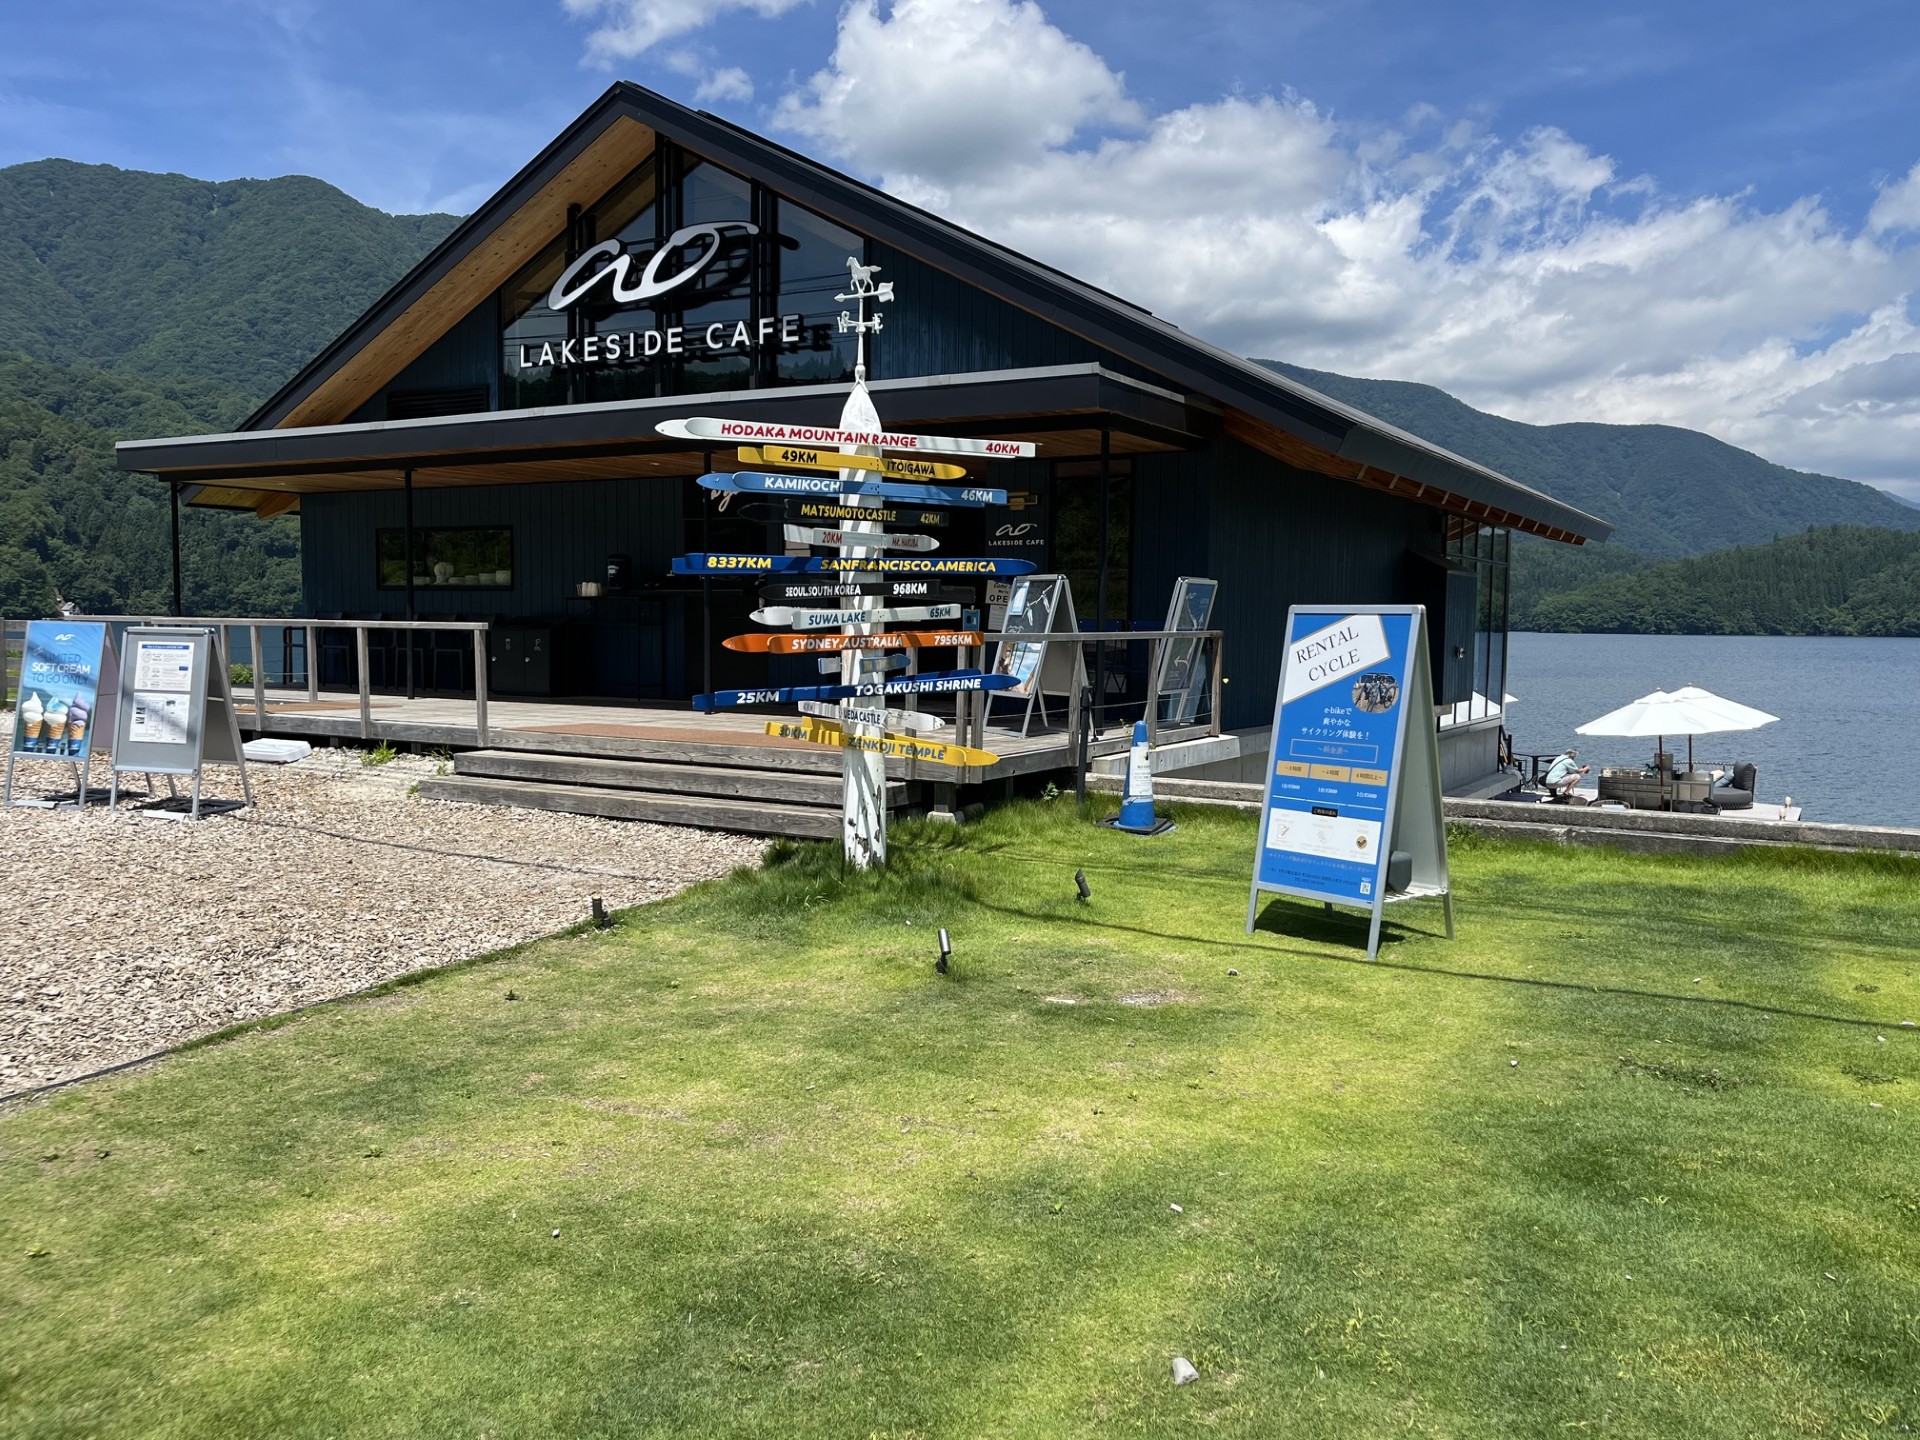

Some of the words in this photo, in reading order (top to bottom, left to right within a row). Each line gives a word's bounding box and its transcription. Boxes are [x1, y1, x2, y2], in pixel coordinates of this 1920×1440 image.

[520, 326, 683, 368] LAKESIDE
[705, 314, 800, 349] CAFE
[721, 424, 786, 439] HODAKA
[789, 428, 869, 444] MOUNTAIN
[872, 434, 917, 448] RANGE
[986, 443, 1020, 454] 40KM
[781, 450, 817, 463] 49KM
[886, 461, 936, 476] ITOIGAWA
[765, 477, 843, 492] KAMIKOCHI
[961, 490, 993, 503] 46KM
[801, 504, 865, 519] MATSUMOTO
[866, 509, 896, 522] CASTLE
[920, 513, 940, 524] 42KM
[822, 531, 842, 544] 20KM
[707, 556, 771, 569] 8337KM
[834, 584, 861, 596] KOREA
[893, 583, 927, 595] 968KM
[989, 594, 1008, 603] OPE
[808, 613, 839, 626] SUWA
[841, 612, 866, 624] LAKE
[929, 607, 951, 618] 65KM
[934, 634, 972, 645] 7956KM
[1296, 626, 1359, 664] RENTAL
[44, 653, 81, 663] LIMITED
[1308, 648, 1360, 682] CYCLE
[32, 662, 57, 672] SOFT
[58, 663, 91, 674] CREAM
[32, 672, 44, 682] TO
[45, 674, 61, 684] GO
[62, 674, 89, 685] ONLY
[737, 690, 780, 704] 25KM
[855, 681, 933, 697] TOGAKUSHI
[935, 678, 981, 692] SHRINE
[844, 710, 859, 721] UEDA
[860, 711, 880, 724] CASTLE
[779, 725, 807, 739] 30KM
[848, 737, 895, 753] ZENKOJI
[899, 744, 945, 760] TEMPLE
